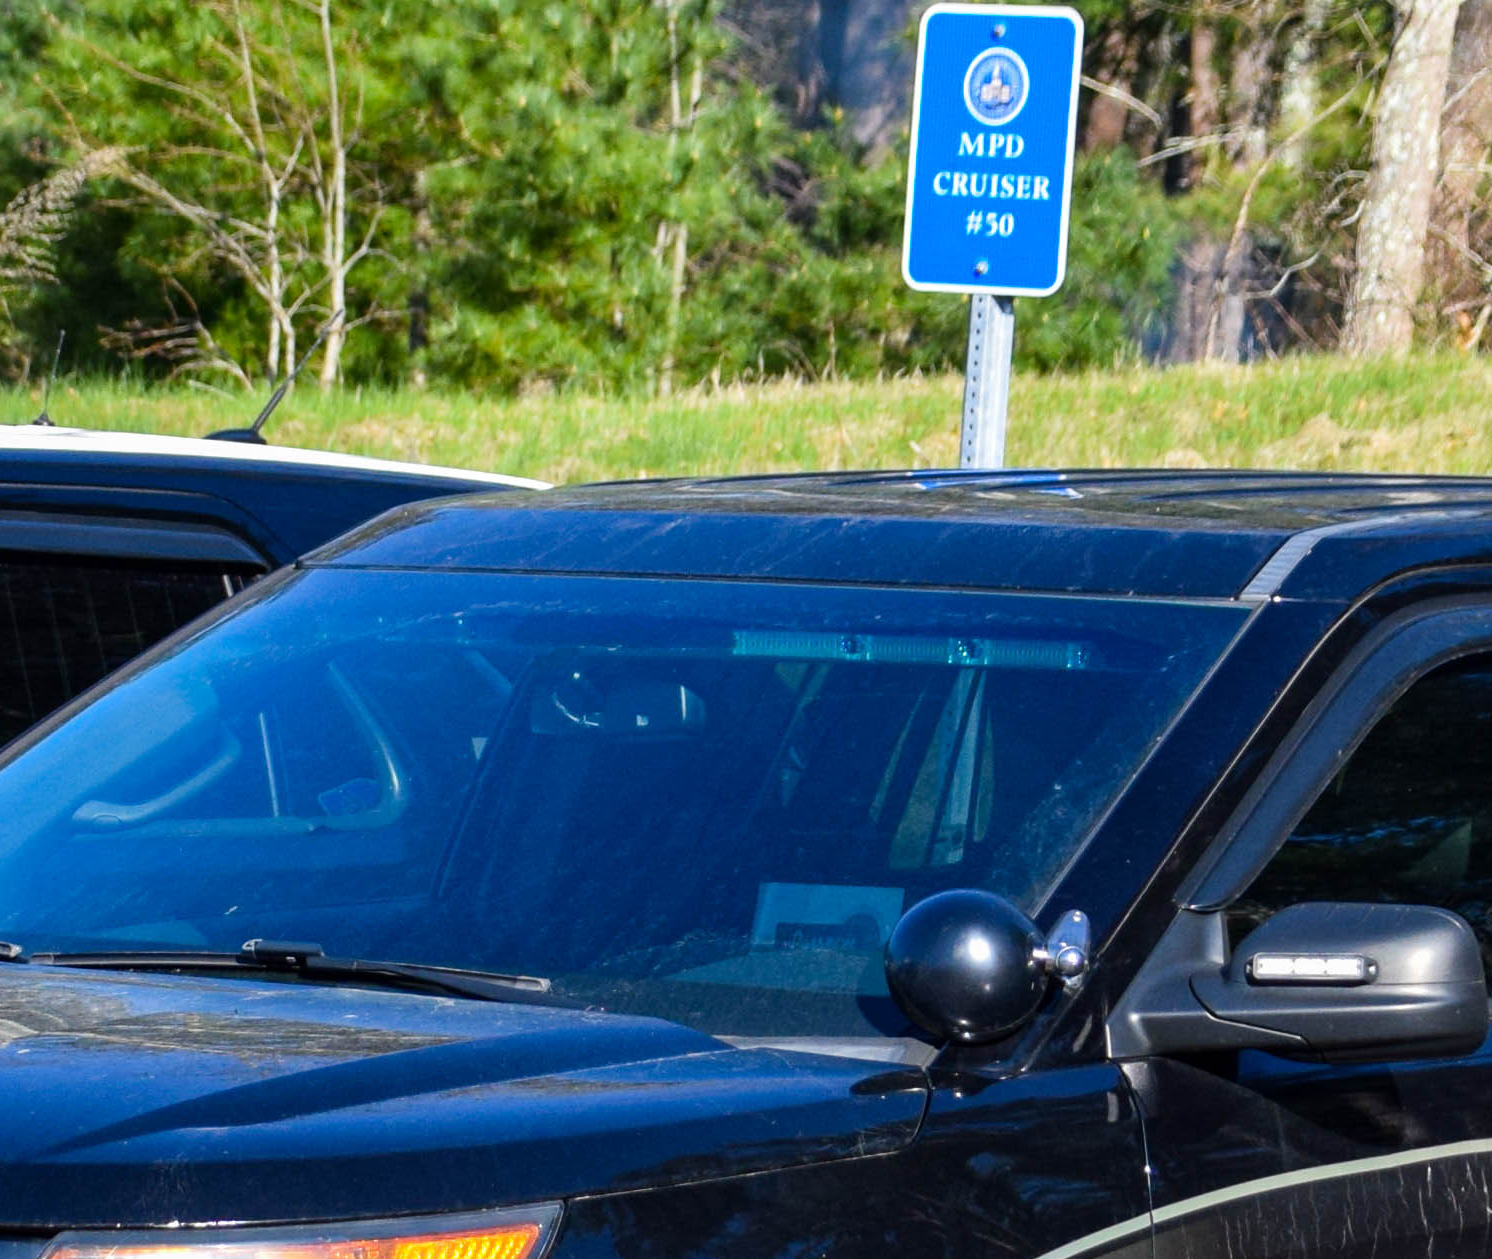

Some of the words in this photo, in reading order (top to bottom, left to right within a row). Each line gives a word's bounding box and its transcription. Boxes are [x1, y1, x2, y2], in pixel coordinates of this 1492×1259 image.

[957, 132, 1024, 158] MPD
[933, 171, 1050, 200] CRUISER
[965, 210, 1015, 237] #50
